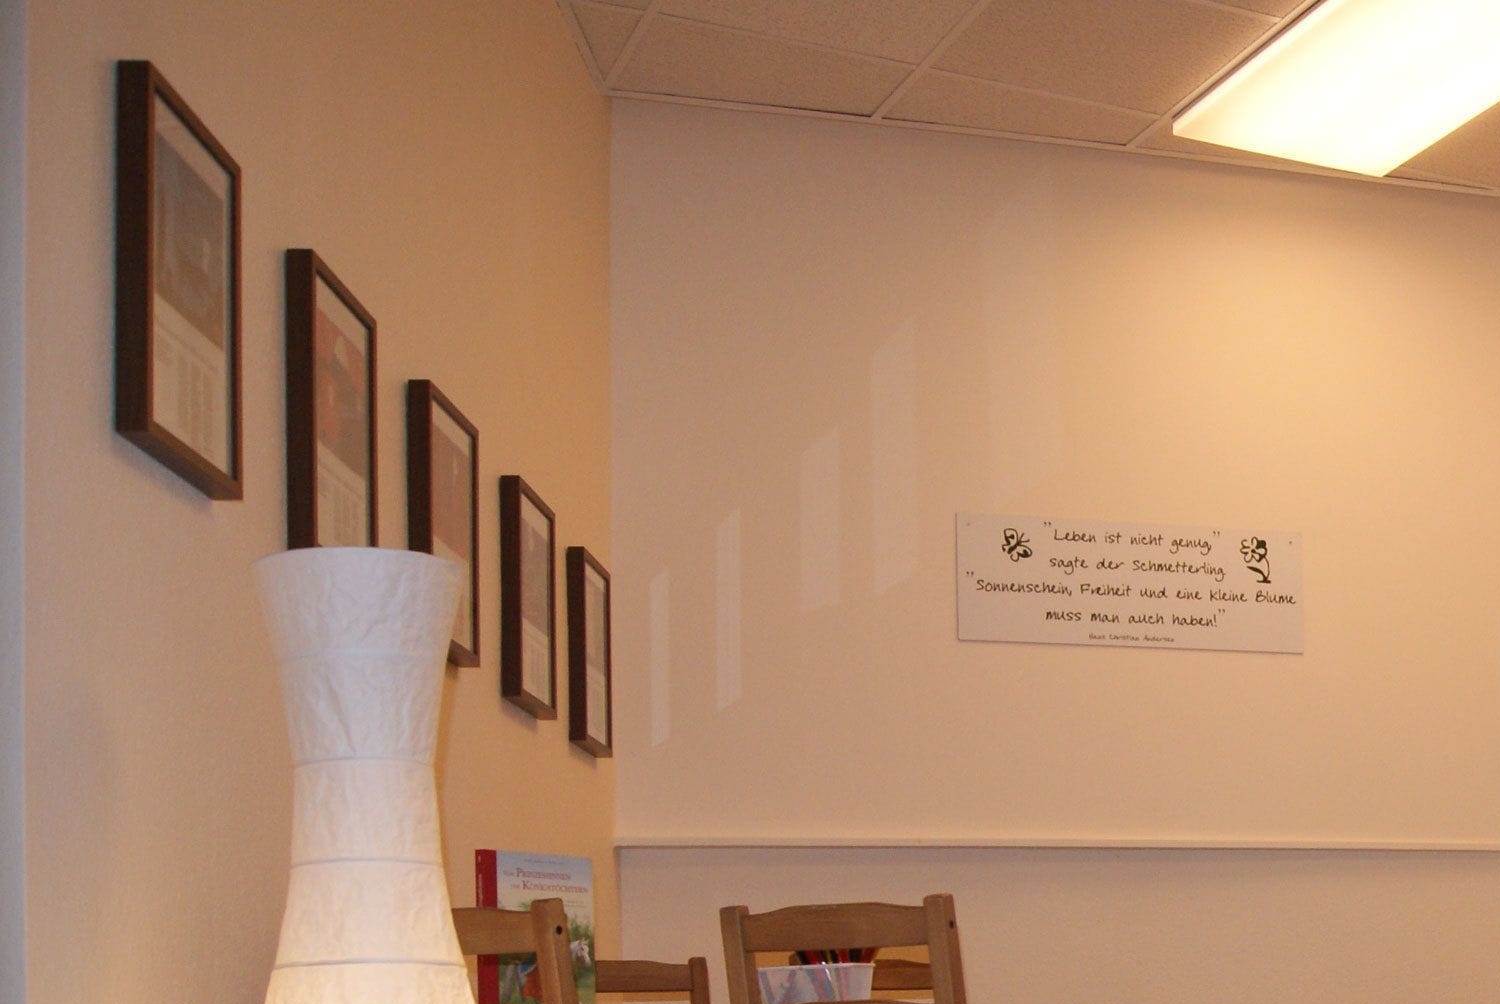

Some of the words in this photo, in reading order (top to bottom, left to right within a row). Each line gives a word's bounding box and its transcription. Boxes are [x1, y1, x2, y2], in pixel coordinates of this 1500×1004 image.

[1104, 531, 1122, 544] ist
[1129, 533, 1164, 546] nicht
[1049, 556, 1088, 575] sagte
[1096, 557, 1124, 570] der
[1132, 560, 1226, 582] Schmetterling
[1080, 583, 1132, 597] Freiheit
[1176, 588, 1202, 600] eine
[1255, 589, 1296, 604] Blume
[1045, 610, 1082, 621] muss
[1090, 611, 1120, 624] man
[1128, 612, 1164, 625] auch
